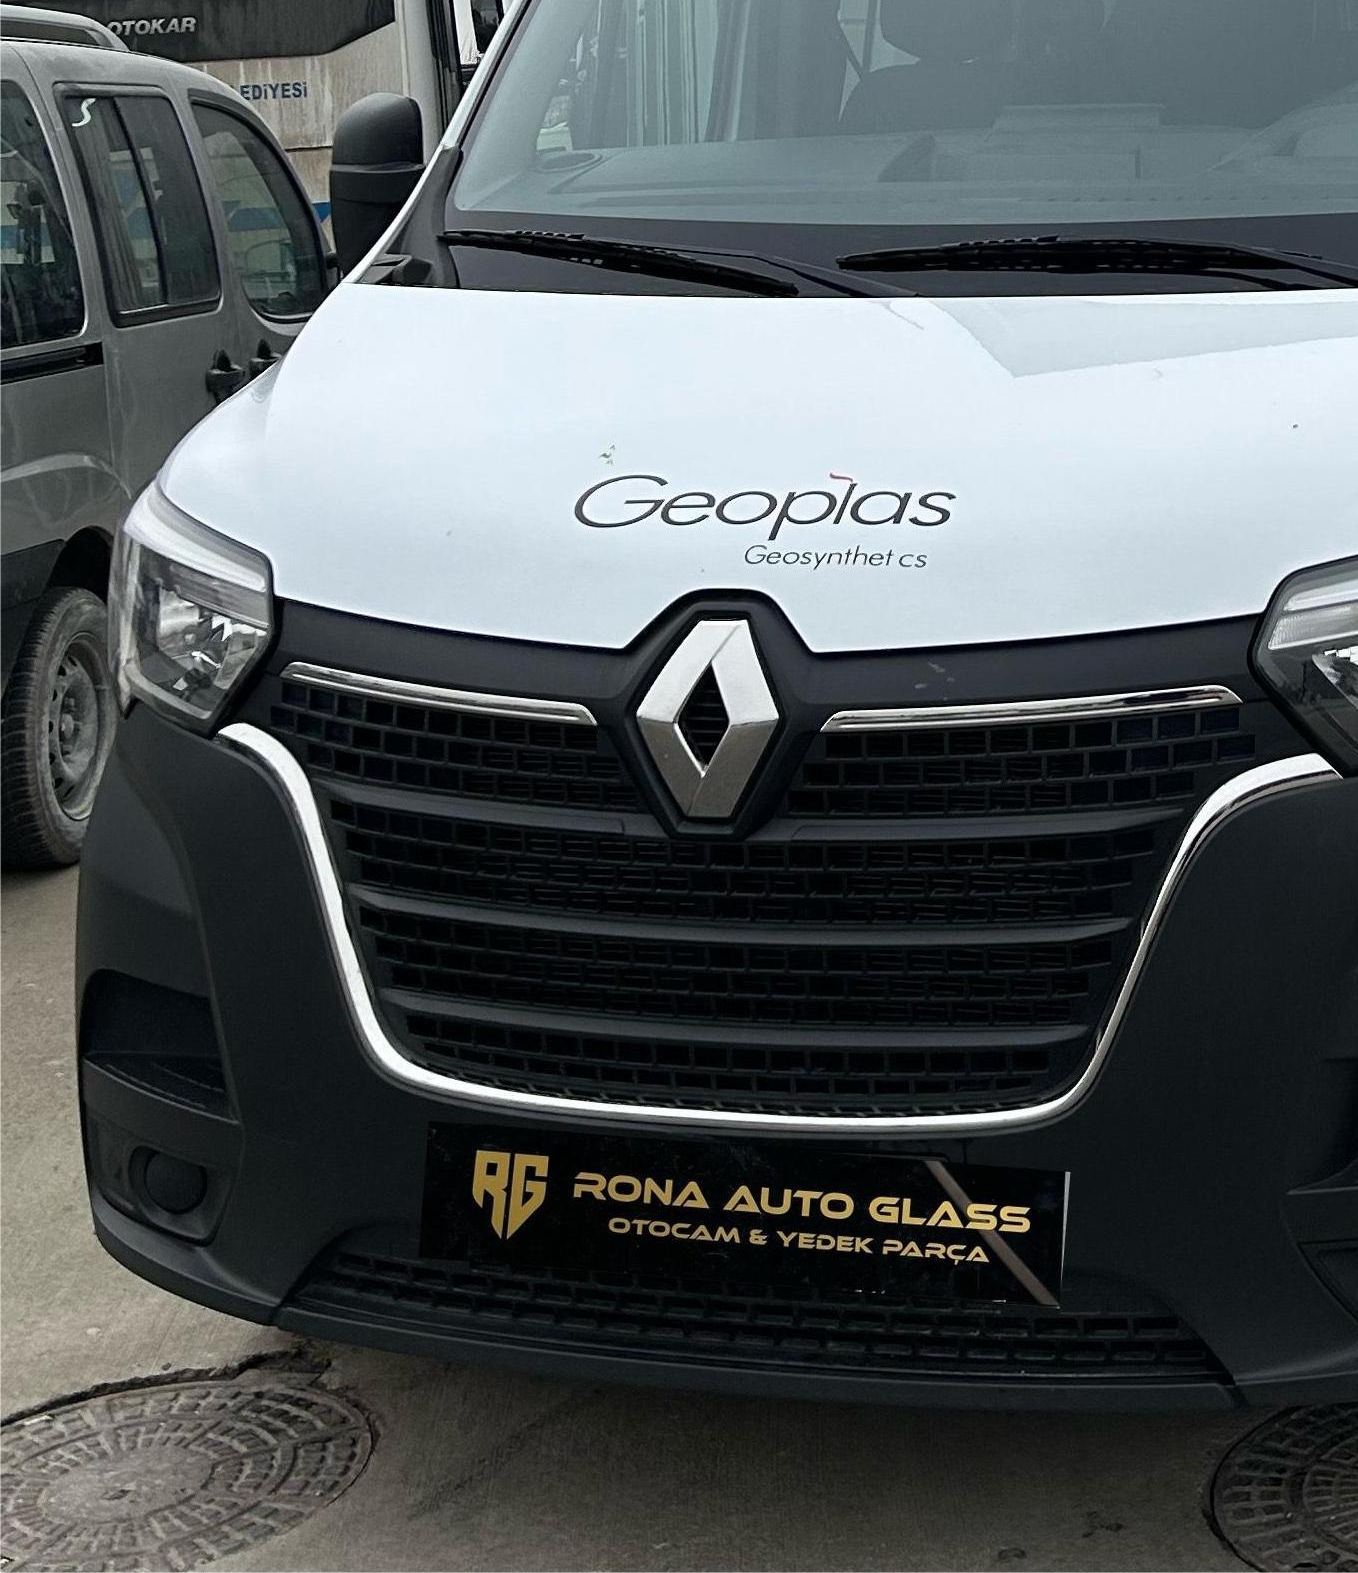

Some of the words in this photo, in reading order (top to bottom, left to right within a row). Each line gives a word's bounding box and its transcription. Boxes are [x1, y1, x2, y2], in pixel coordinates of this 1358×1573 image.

[107, 16, 197, 36] OTOKAR
[239, 81, 308, 101] EDİYESİ
[744, 544, 928, 571] Geosynthetcs
[572, 1171, 710, 1211] RONA
[722, 1184, 855, 1220] AUTO
[868, 1196, 1032, 1234] GLASS
[607, 1216, 741, 1245] OTOCAM
[748, 1229, 768, 1246] &
[776, 1230, 874, 1255] YEDEK
[881, 1237, 991, 1266] PARÇA
